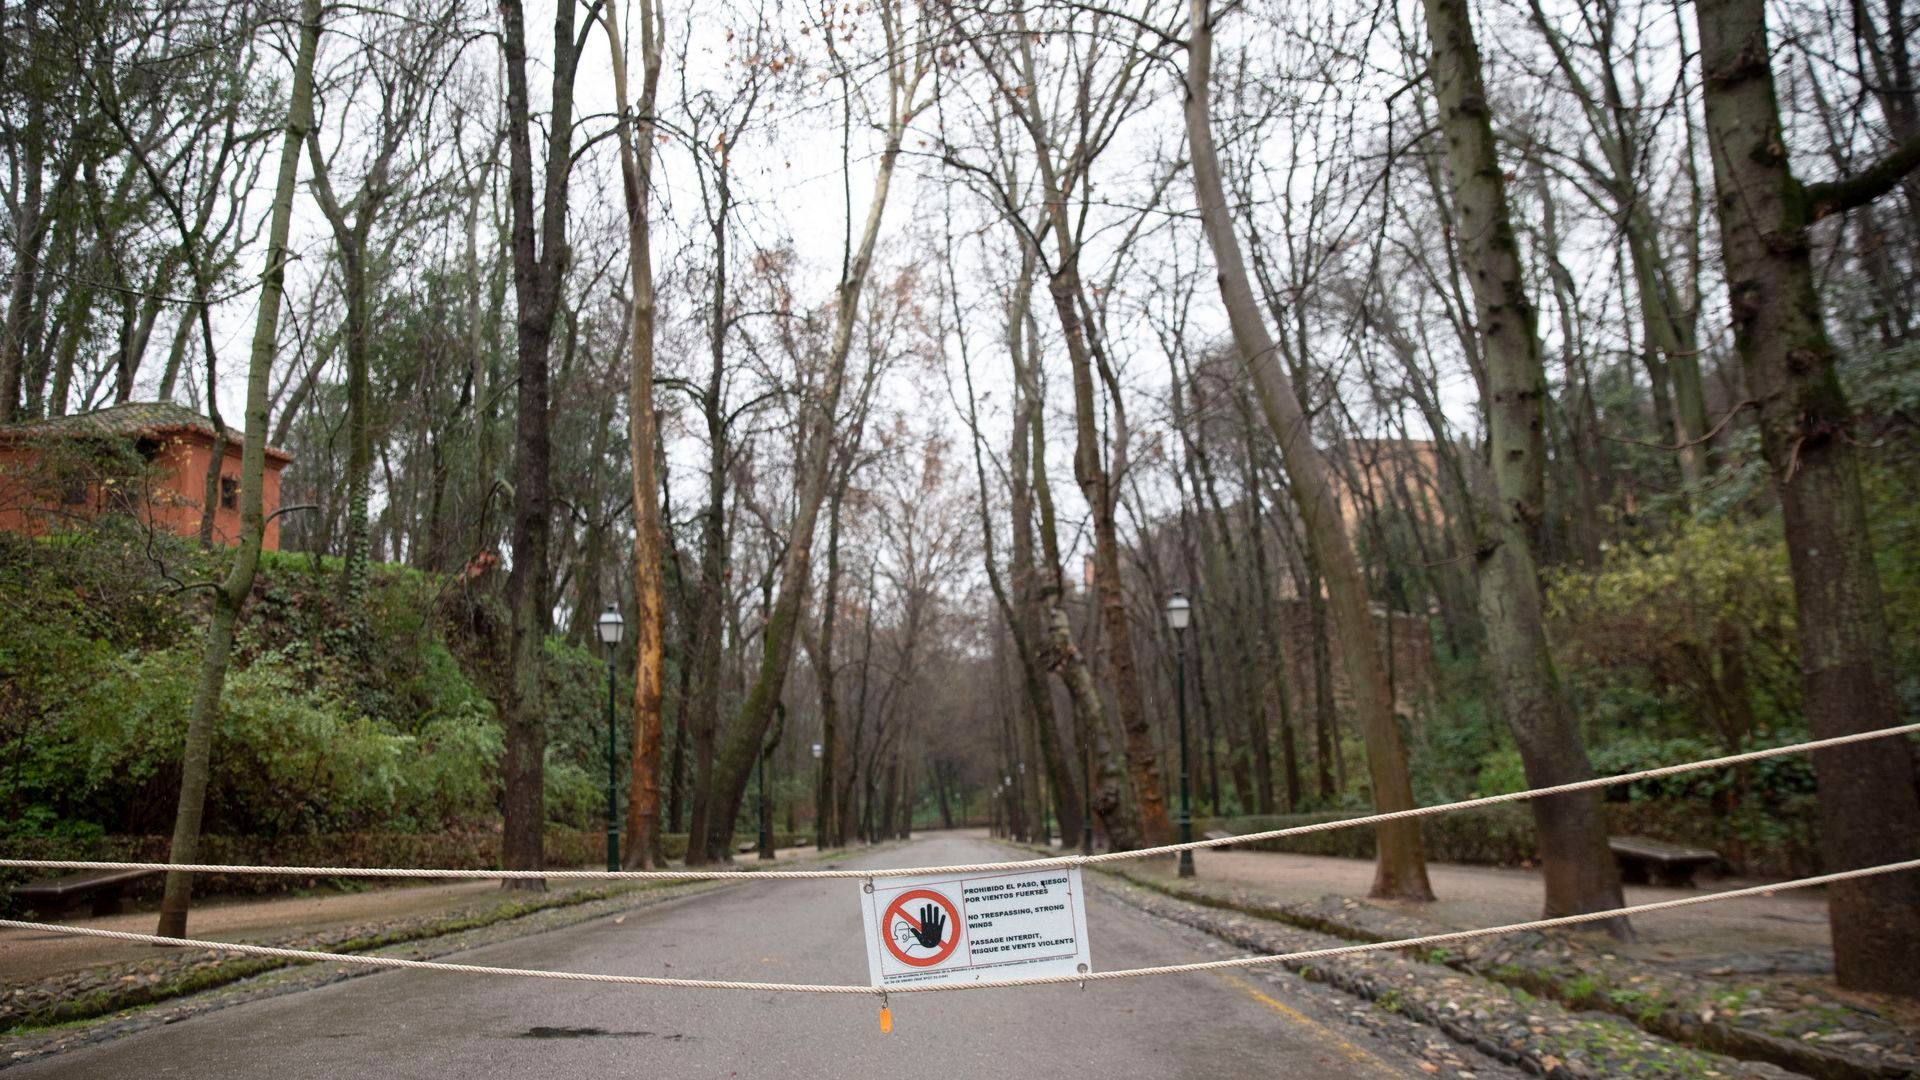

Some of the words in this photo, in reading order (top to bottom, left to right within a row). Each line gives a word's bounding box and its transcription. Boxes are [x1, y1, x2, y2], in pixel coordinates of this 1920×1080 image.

[964, 885, 1004, 894] PROHIBIDO
[982, 893, 1013, 901] VIENTOS
[1016, 889, 1048, 897] FUERTES
[981, 908, 1033, 919] TRESPASSING,
[1035, 904, 1064, 913] STRONG
[1006, 933, 1042, 941] INTERDIT,
[972, 946, 998, 954] RISQUE
[1038, 938, 1074, 947] VIOLENTS
